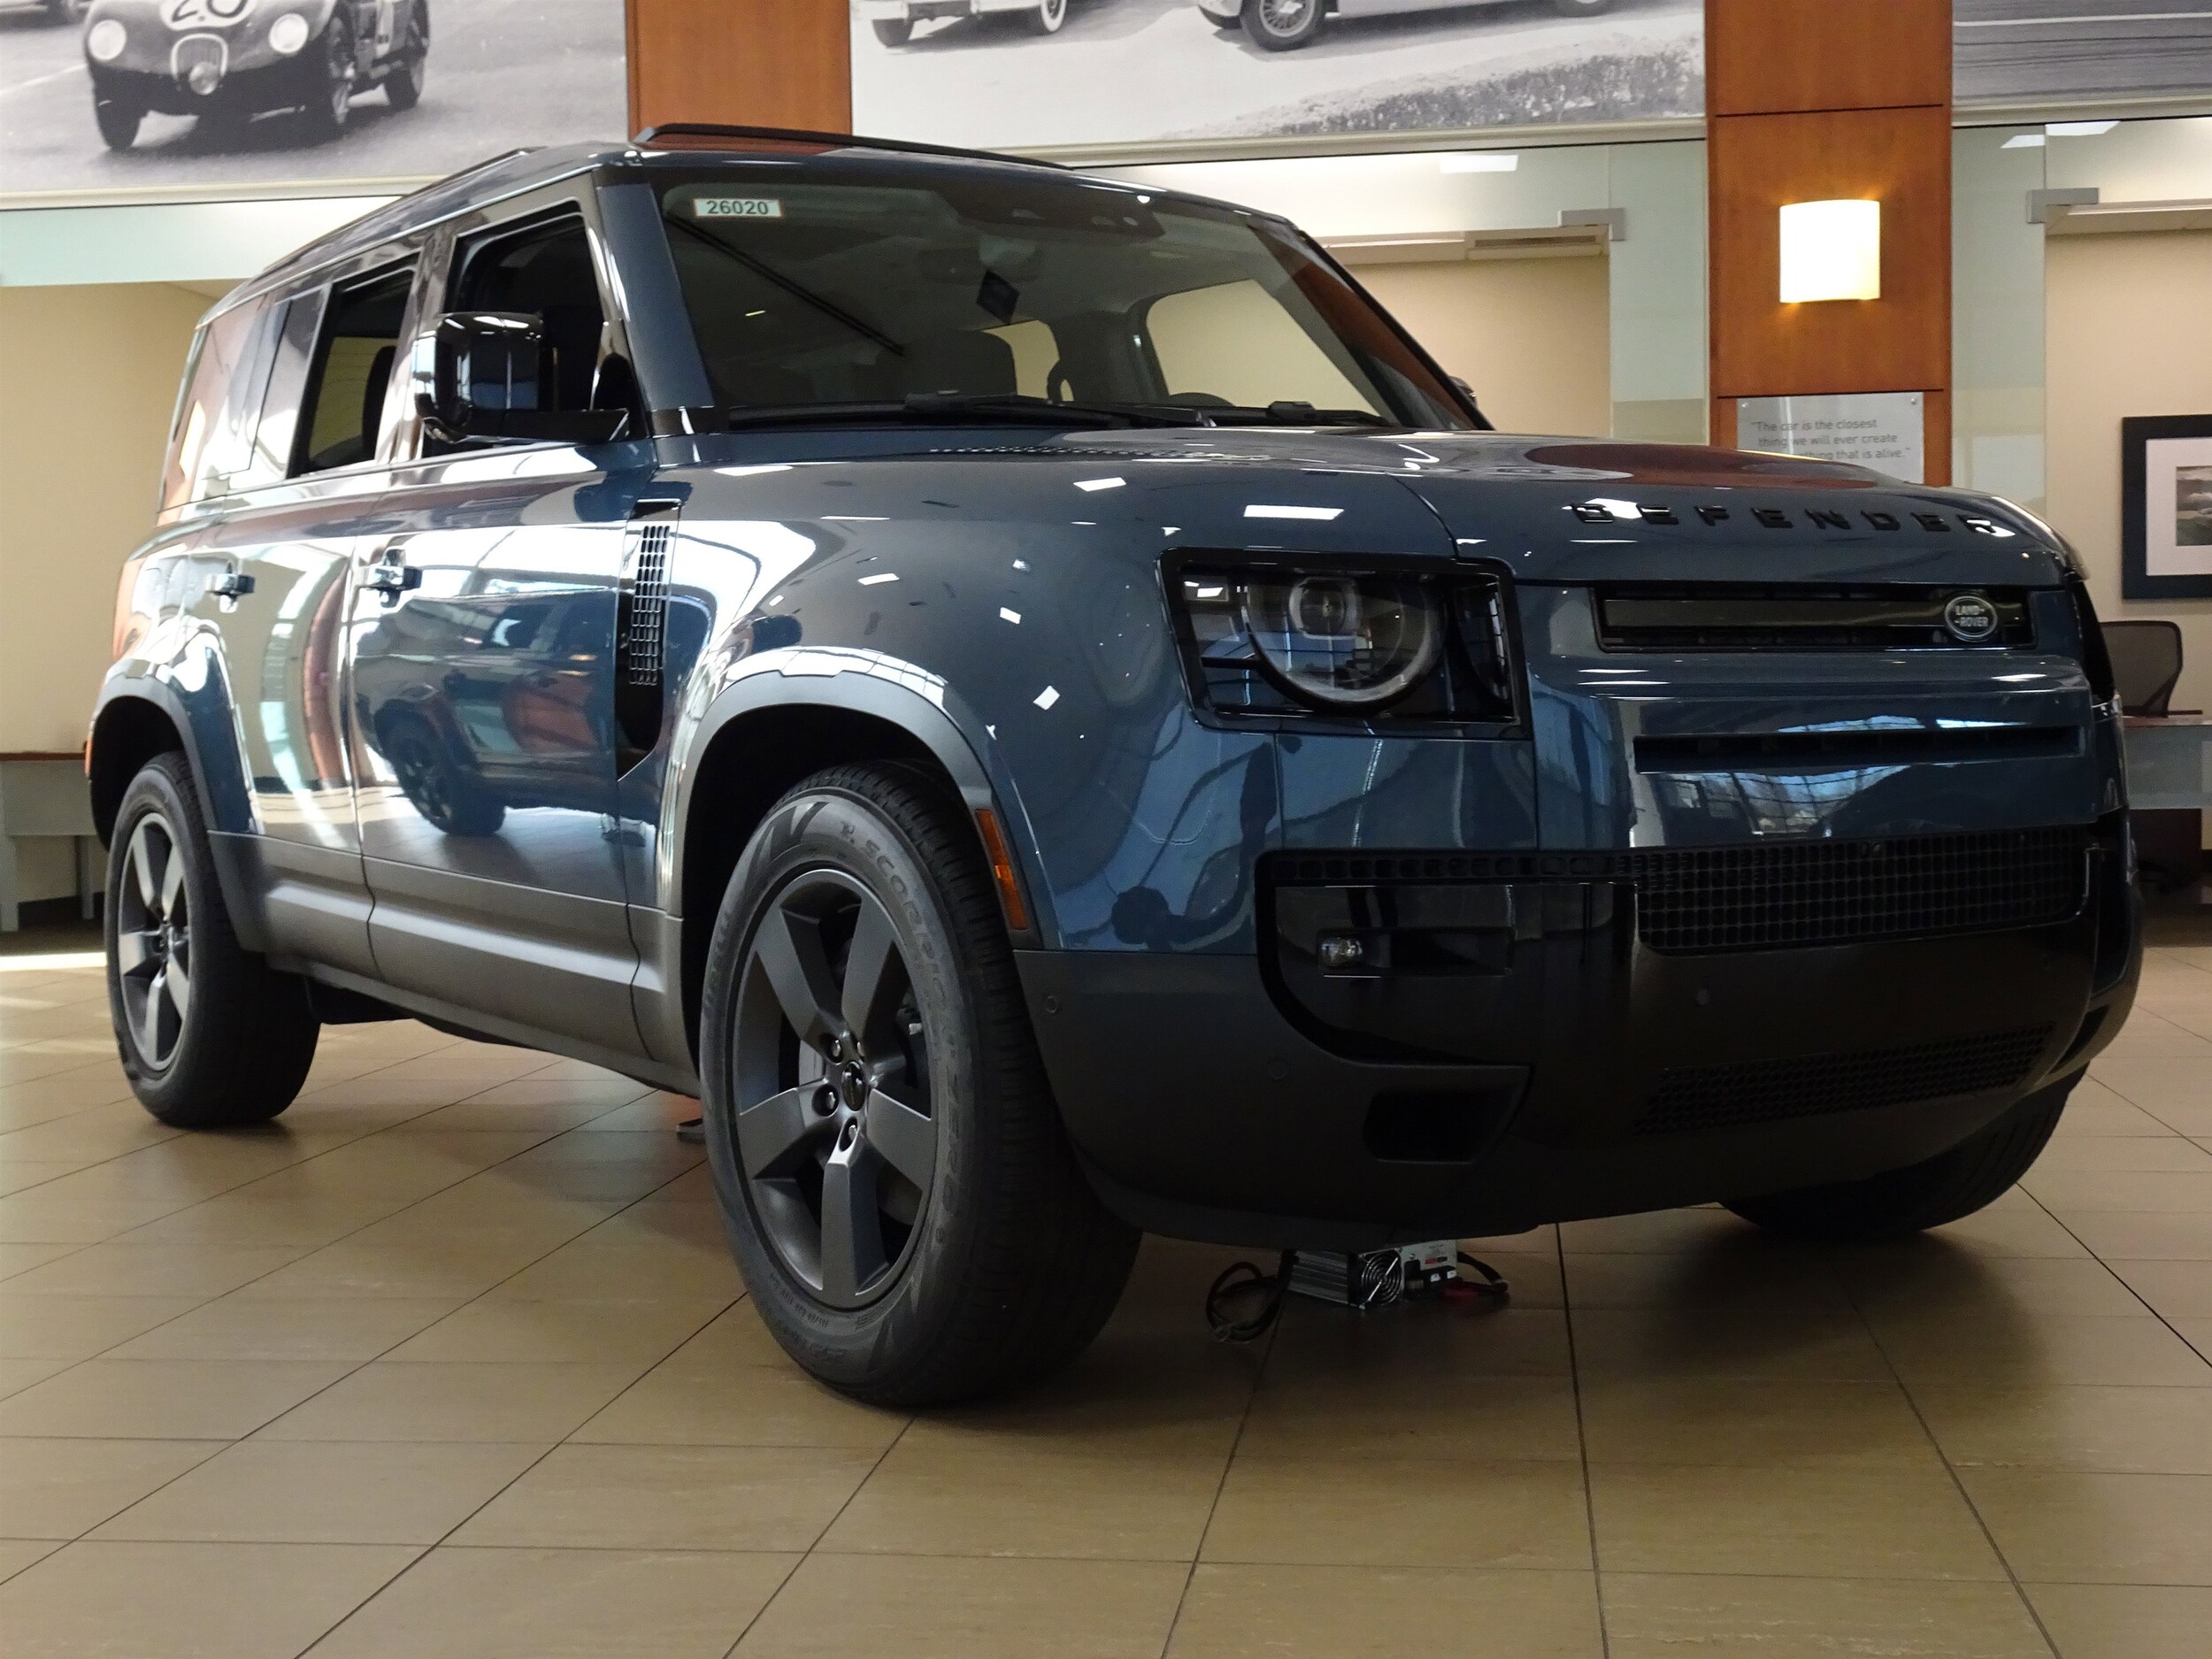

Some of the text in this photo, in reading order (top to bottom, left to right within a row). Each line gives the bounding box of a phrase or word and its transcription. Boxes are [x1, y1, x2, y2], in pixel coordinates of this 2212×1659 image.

[706, 200, 769, 215] 26020
[1801, 421, 1812, 431] is
[1814, 420, 1833, 430] the
[1835, 419, 1878, 430] closest
[1757, 437, 1787, 449] thing
[1810, 434, 1832, 445] will
[1833, 435, 1858, 445] ever
[1861, 434, 1898, 444] create
[1835, 449, 1859, 460] that
[1862, 449, 1872, 459] is
[1571, 502, 1999, 533] DEFENDER
